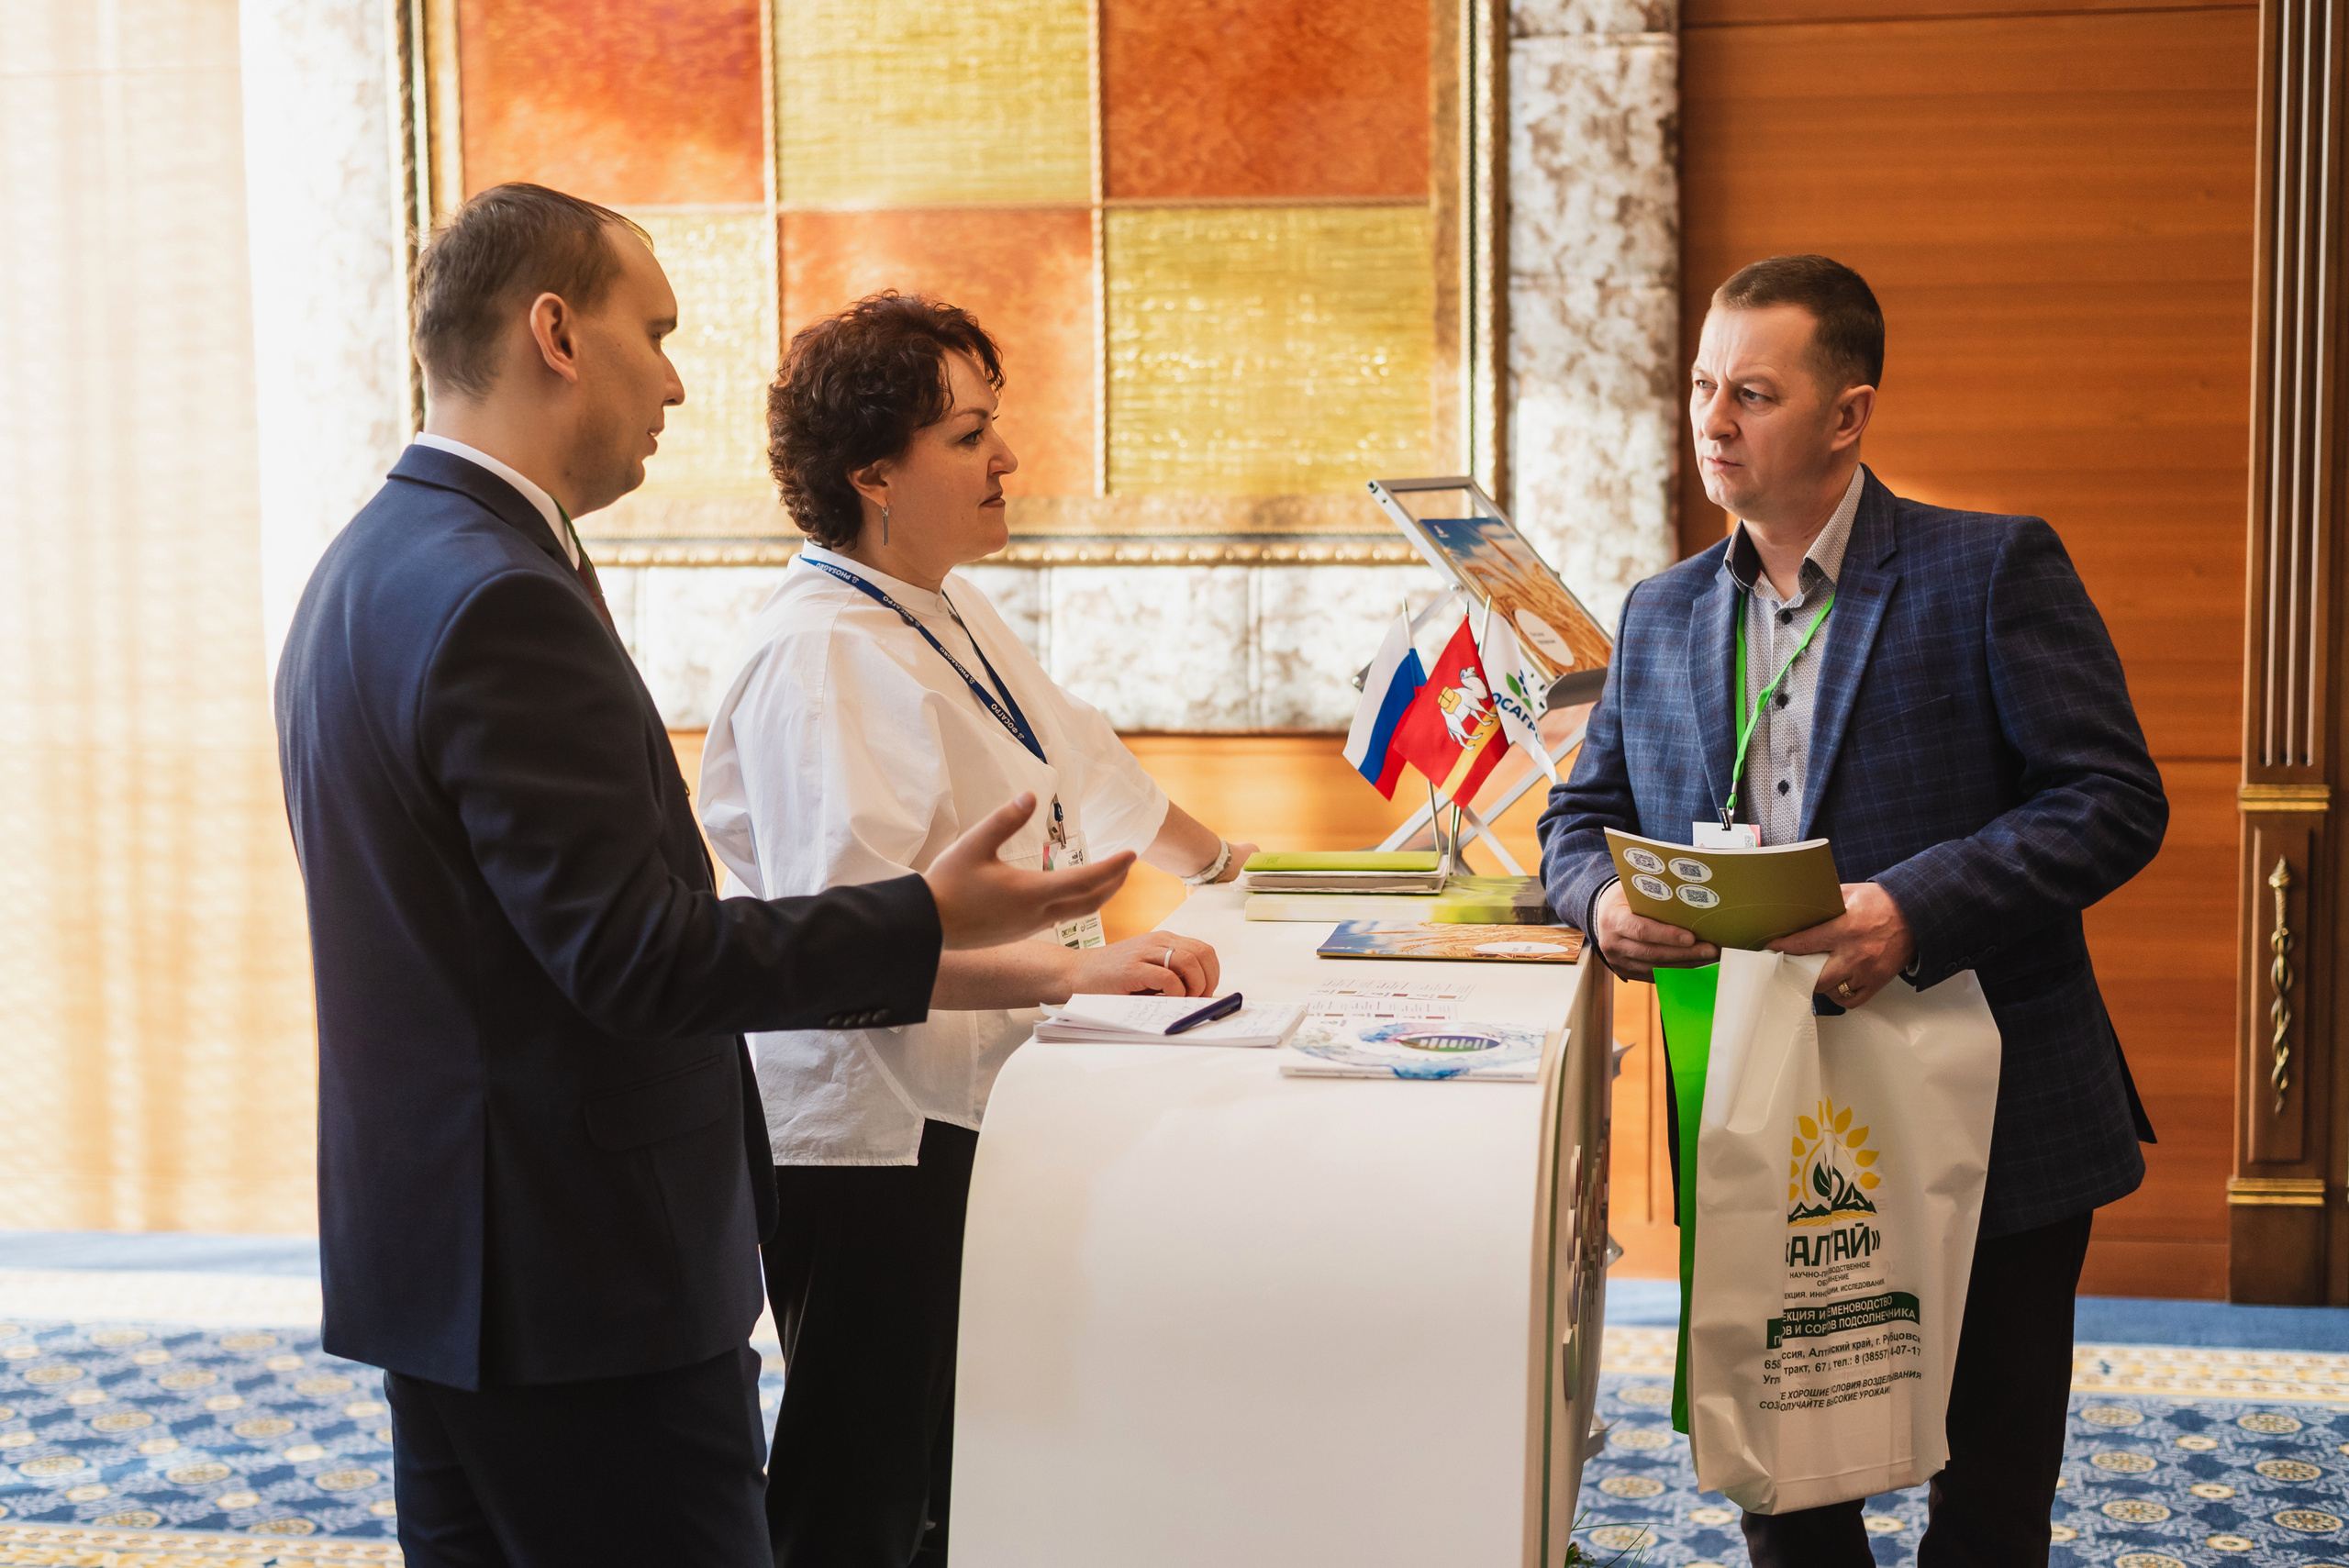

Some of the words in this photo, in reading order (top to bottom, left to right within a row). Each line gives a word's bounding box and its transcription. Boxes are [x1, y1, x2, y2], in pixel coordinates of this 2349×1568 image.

[991, 703, 1019, 734] ФОСАГРО
[1839, 1307, 1917, 1329] ПОДСОЛНЕЧНИКА
[1852, 1337, 1874, 1351] край,
[1784, 1364, 1810, 1376] тракт,
[1815, 1362, 1827, 1373] 67
[1833, 1358, 1852, 1368] тел.:
[1854, 1354, 1860, 1364] 8
[1787, 1387, 1830, 1399] ХОРОШИЕ
